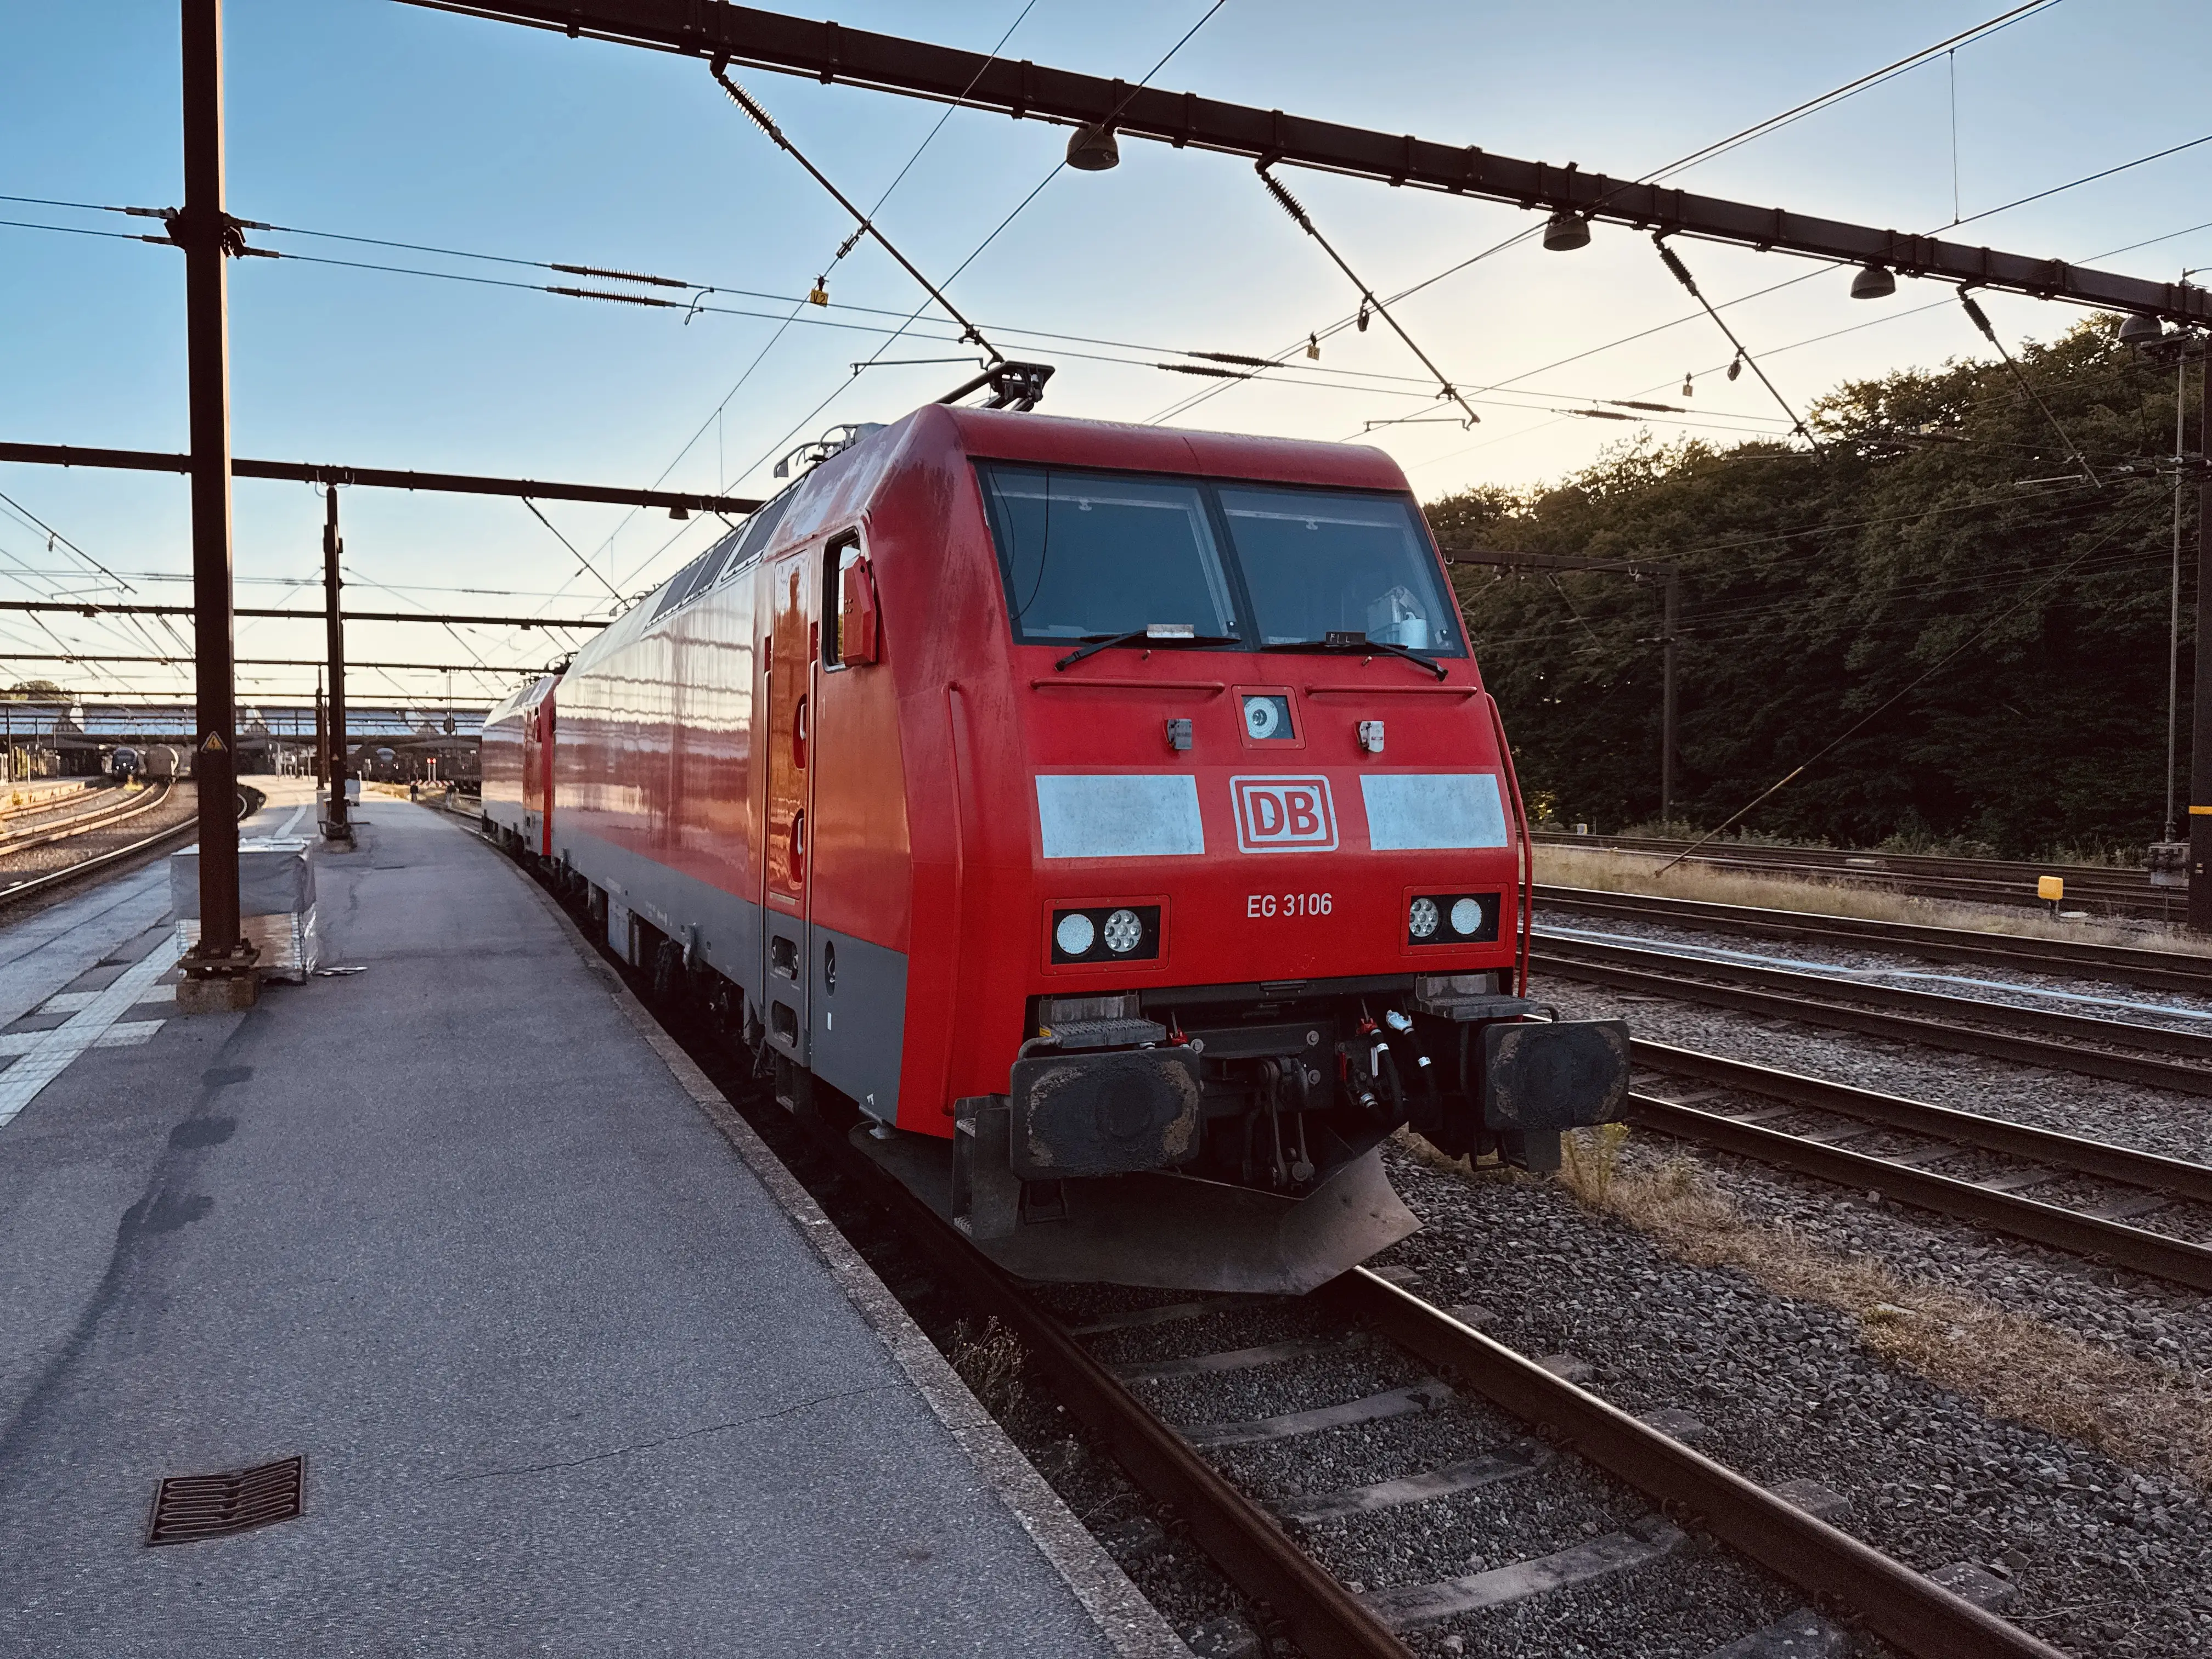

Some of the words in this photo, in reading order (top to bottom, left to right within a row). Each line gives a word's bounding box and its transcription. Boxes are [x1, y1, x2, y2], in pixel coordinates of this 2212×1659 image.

[1249, 791, 1319, 837] DB
[1247, 894, 1277, 918] EG
[1283, 893, 1333, 917] 3106
